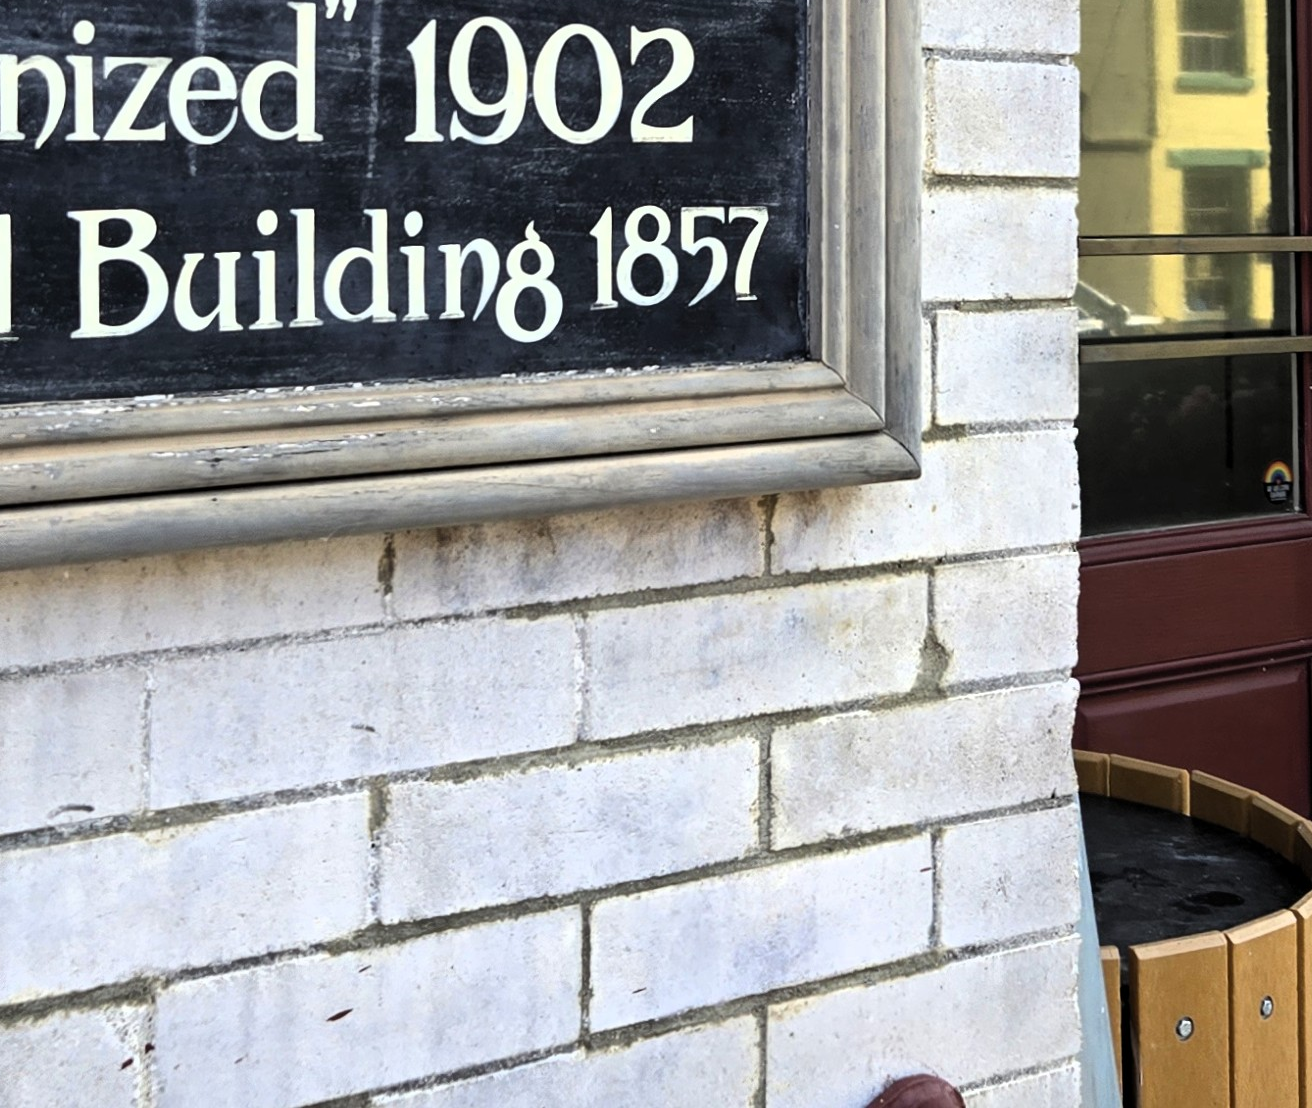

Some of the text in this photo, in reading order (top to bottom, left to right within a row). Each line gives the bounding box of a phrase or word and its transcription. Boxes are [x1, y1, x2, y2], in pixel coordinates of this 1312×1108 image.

[403, 17, 696, 146] 1902
[64, 207, 565, 344] Building
[588, 203, 770, 312] 1857
